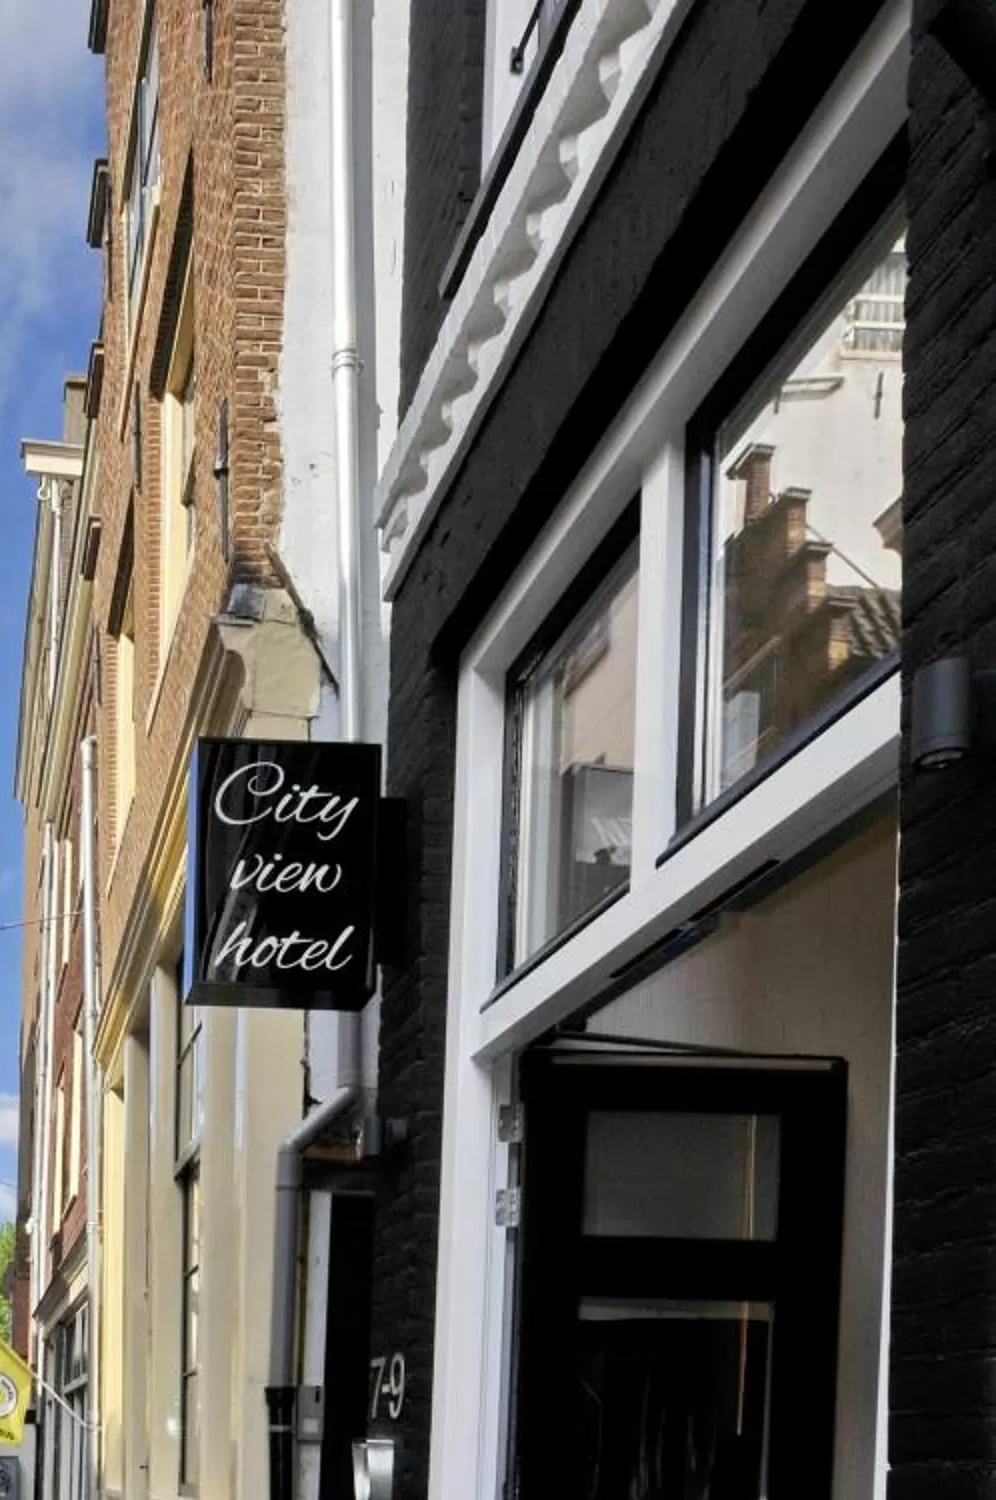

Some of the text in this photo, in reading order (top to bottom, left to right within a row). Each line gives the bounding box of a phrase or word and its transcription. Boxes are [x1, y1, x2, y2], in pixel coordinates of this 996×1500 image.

[214, 761, 359, 841] City
[230, 853, 342, 893] view
[214, 920, 355, 971] hotel
[370, 1352, 405, 1420] 7-9
